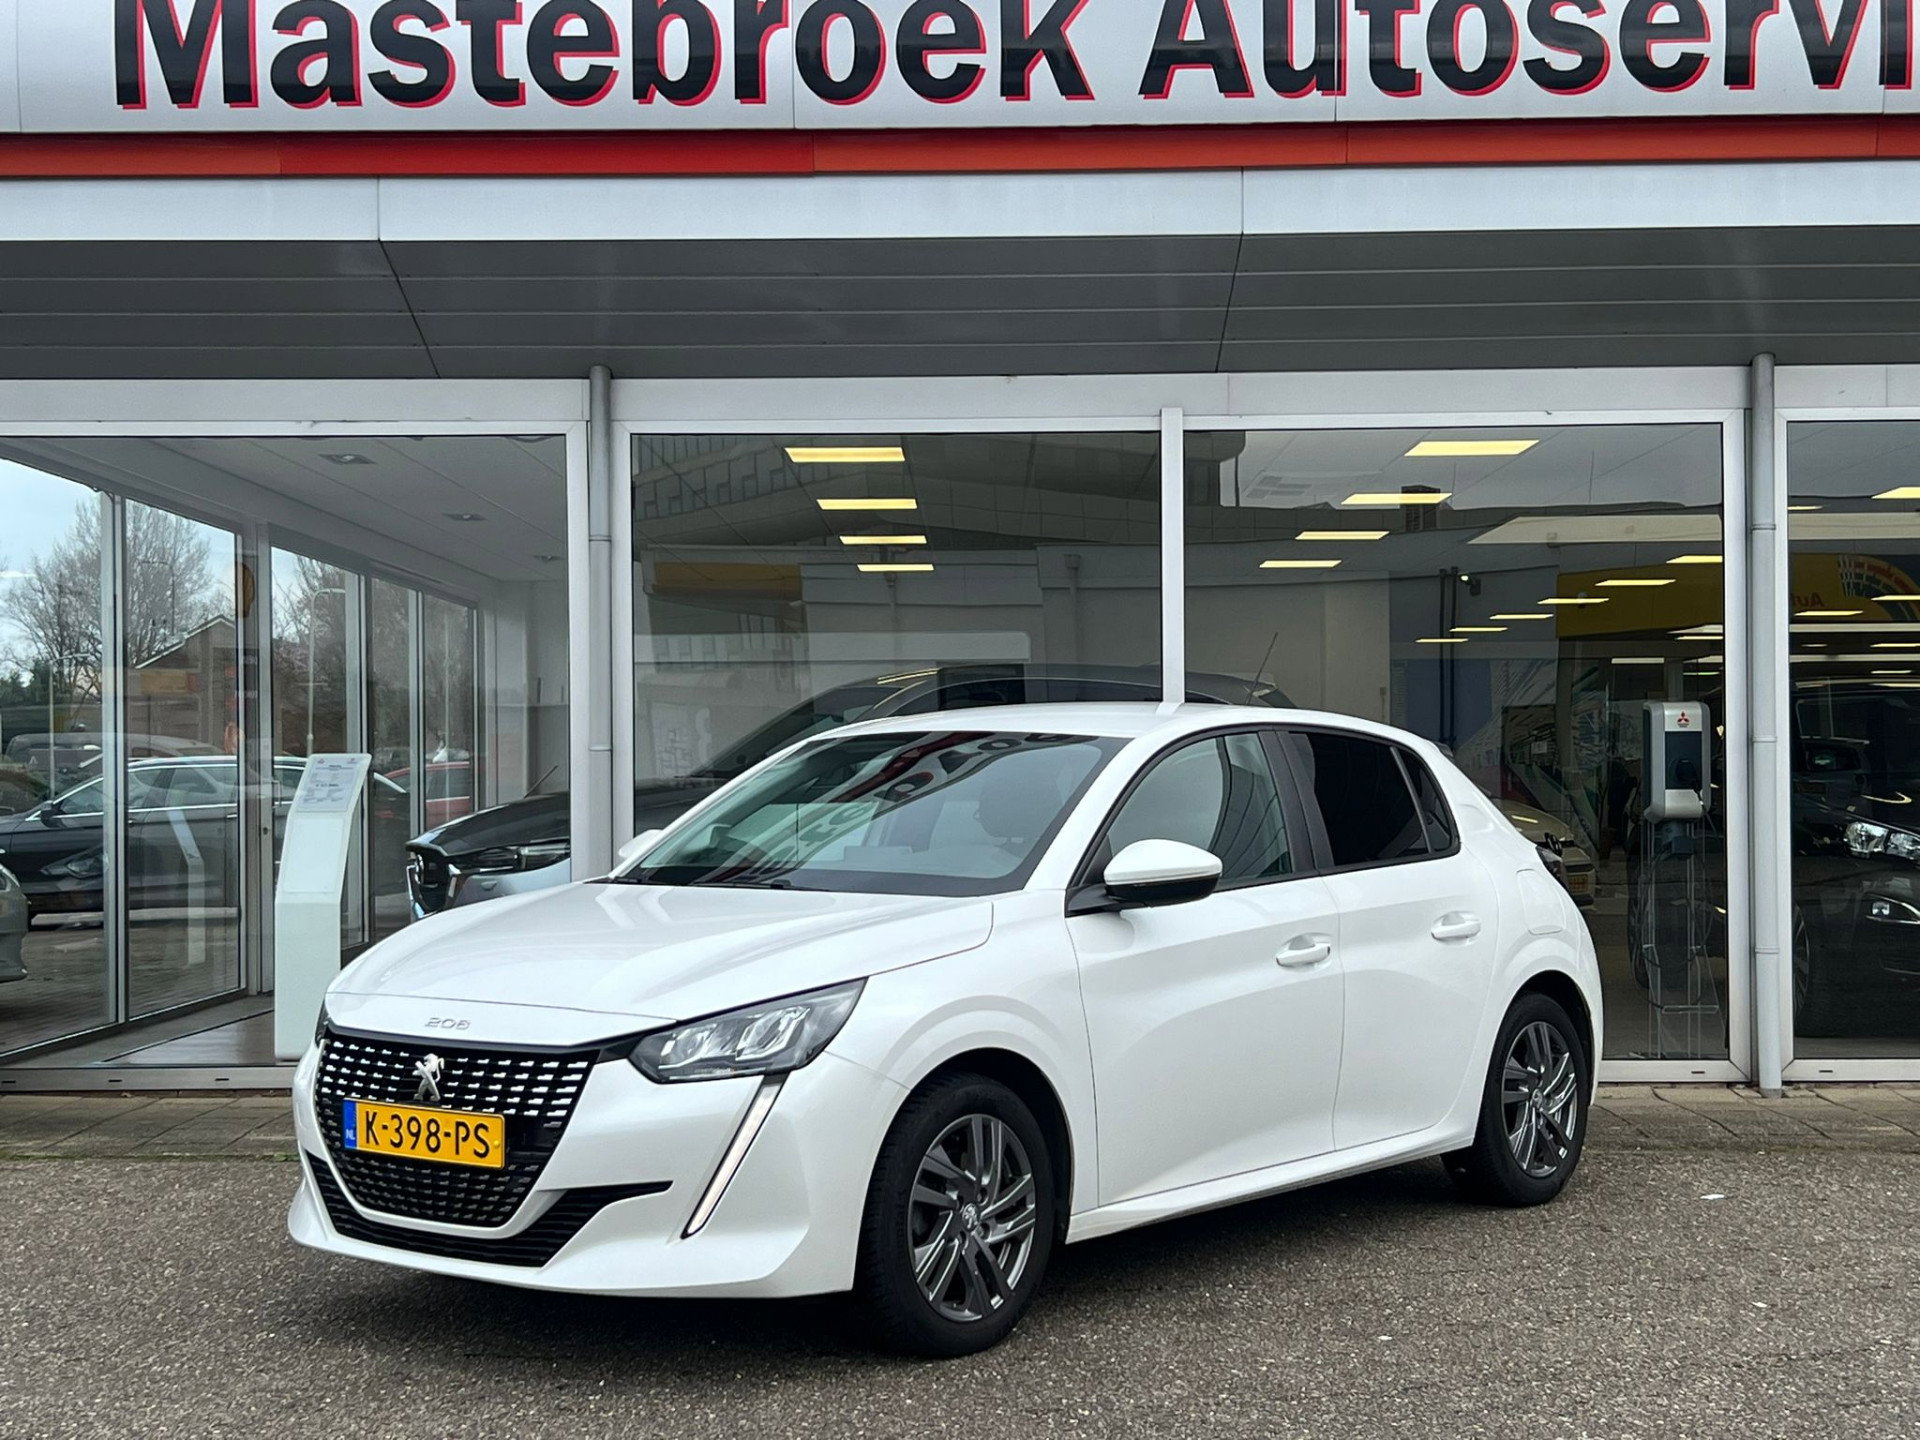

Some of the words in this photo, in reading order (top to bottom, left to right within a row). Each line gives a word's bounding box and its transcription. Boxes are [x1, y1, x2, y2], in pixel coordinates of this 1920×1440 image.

[114, 0, 1093, 110] Mastebroek
[345, 1129, 356, 1140] NL
[364, 1109, 491, 1159] K-398-PS
